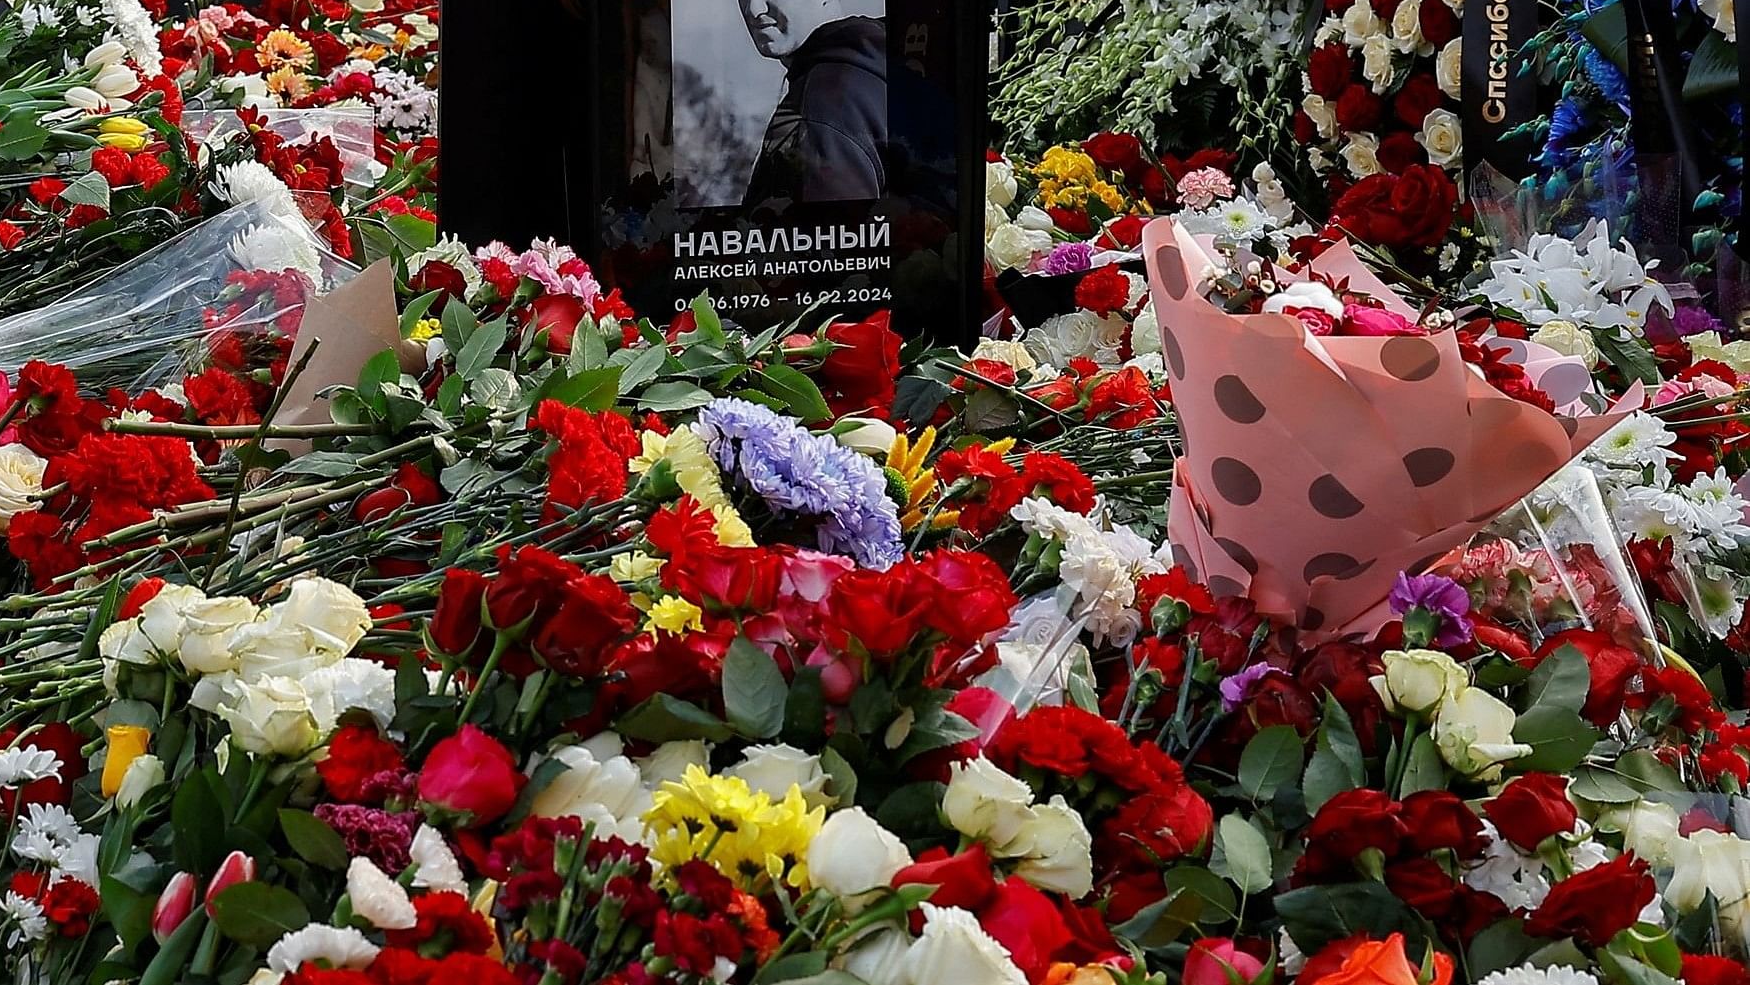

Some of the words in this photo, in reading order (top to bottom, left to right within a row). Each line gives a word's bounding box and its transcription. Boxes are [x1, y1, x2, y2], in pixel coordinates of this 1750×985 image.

[674, 216, 890, 257] НАВАЛЬНЫЙ
[674, 261, 758, 280] АЛЕКСЕЙ
[764, 257, 891, 275] АНАТОЛЬЕВИЧ
[674, 294, 770, 312] 06.1976
[795, 287, 892, 305] 1602.2024
